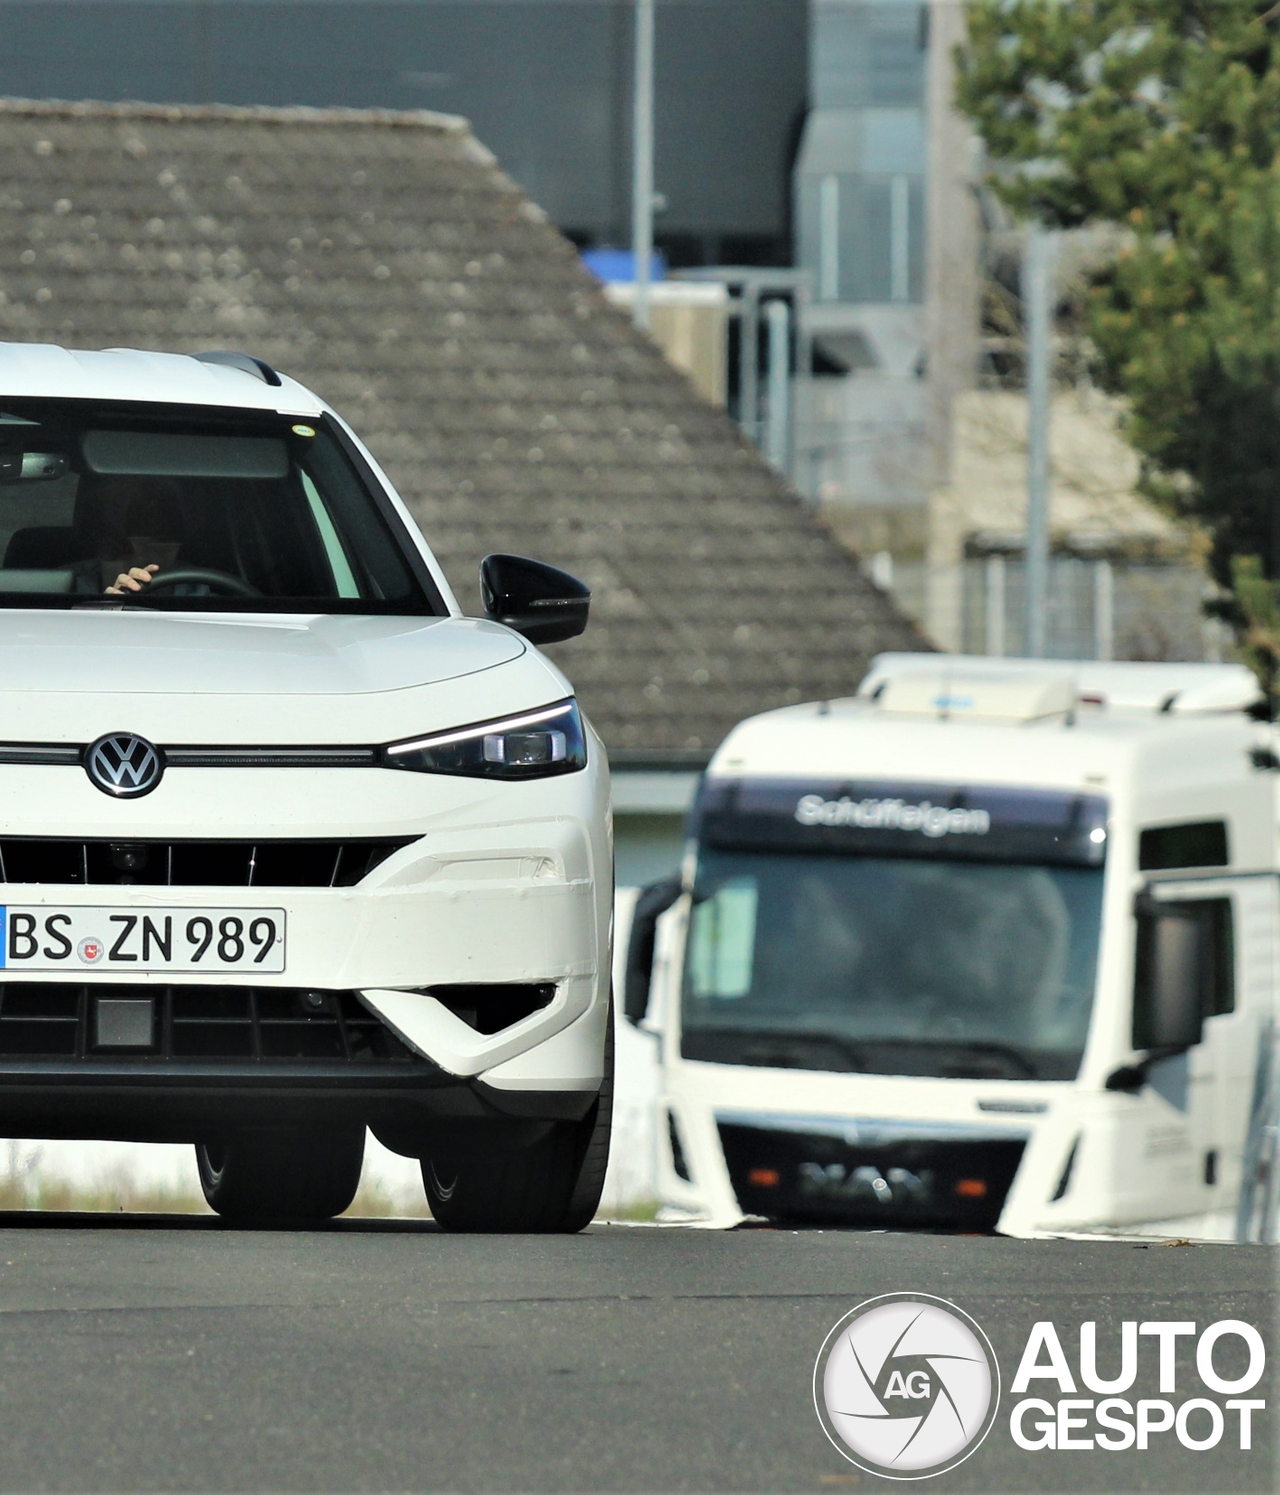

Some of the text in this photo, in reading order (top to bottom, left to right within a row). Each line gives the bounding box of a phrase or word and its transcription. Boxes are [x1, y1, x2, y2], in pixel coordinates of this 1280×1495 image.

[94, 736, 155, 787] VW
[9, 913, 276, 963] BS ZN 989
